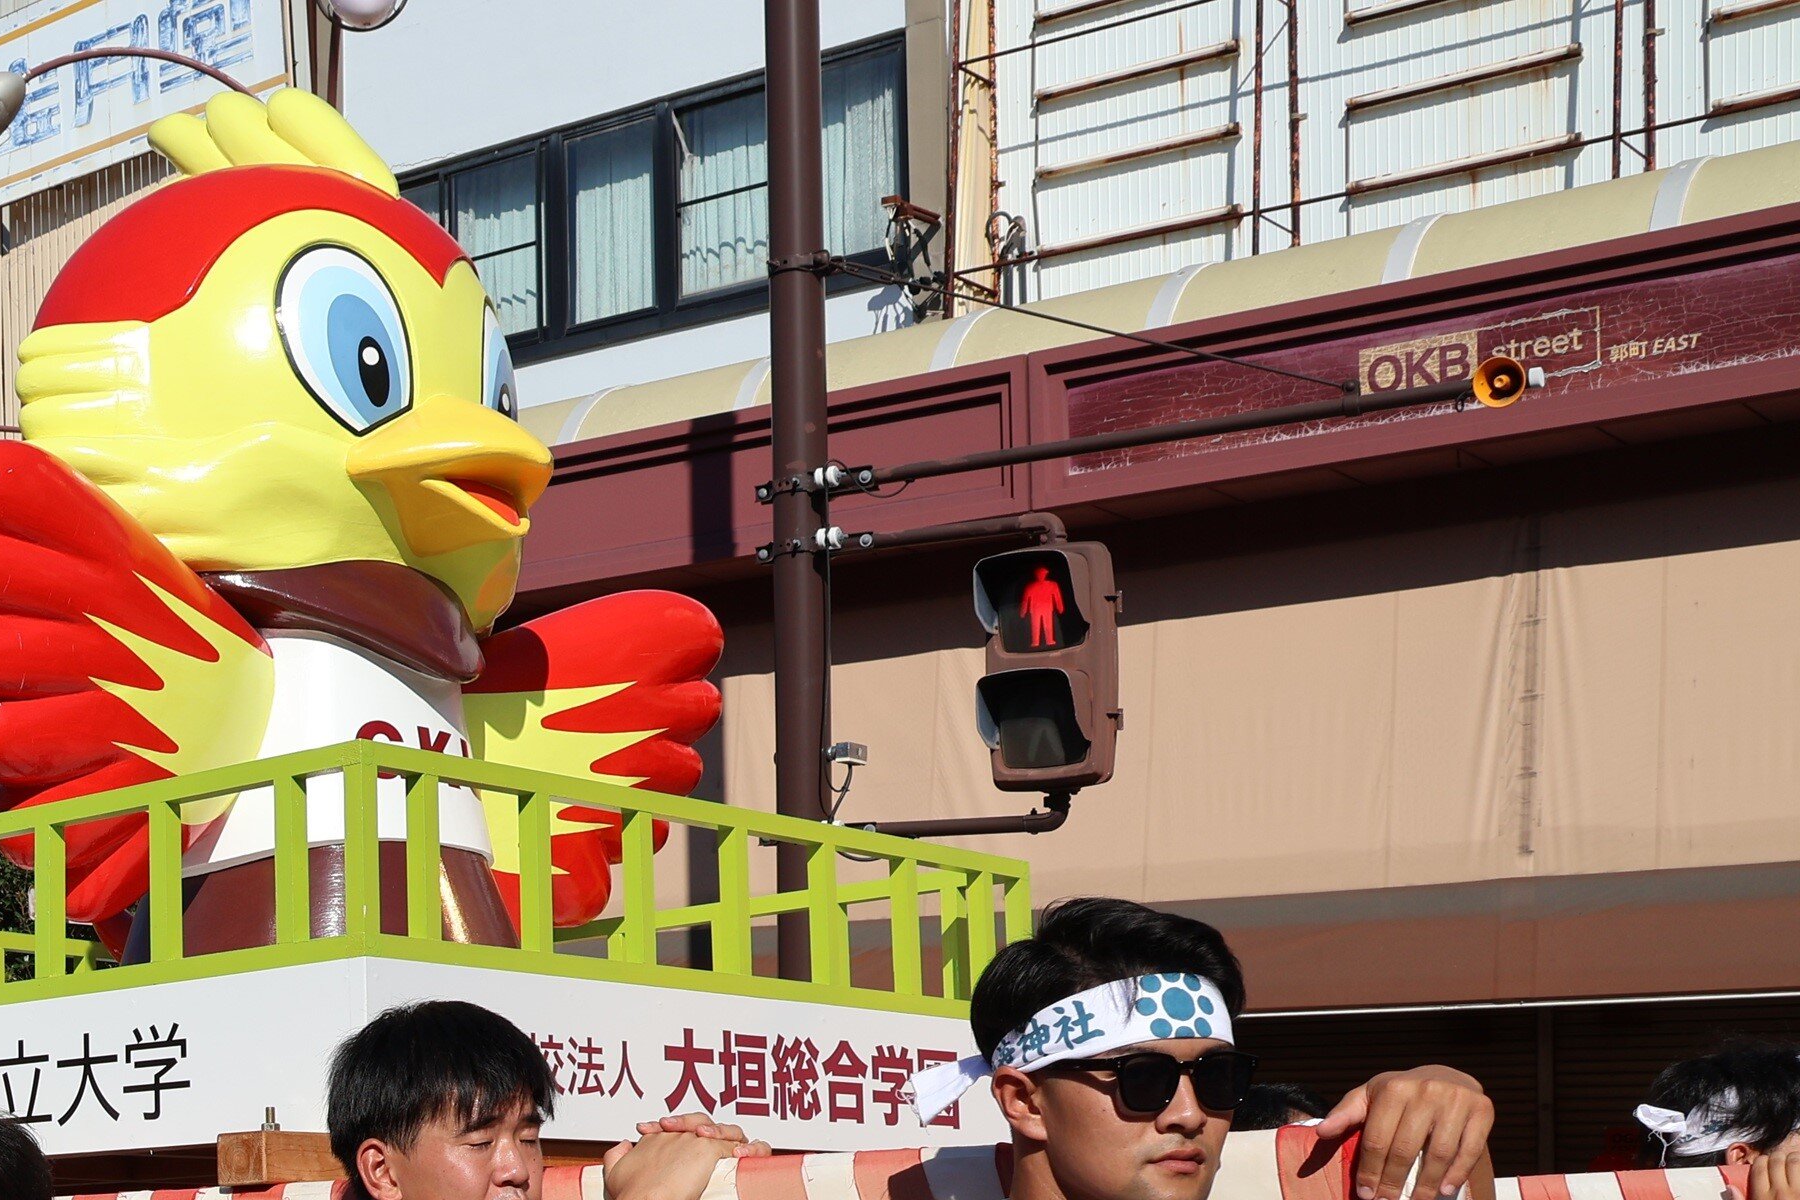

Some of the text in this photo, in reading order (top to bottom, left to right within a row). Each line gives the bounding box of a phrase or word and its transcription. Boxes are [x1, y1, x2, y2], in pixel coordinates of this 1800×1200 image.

[1367, 327, 1584, 394] OKB street
[1609, 332, 1703, 363] 郭町 EAST
